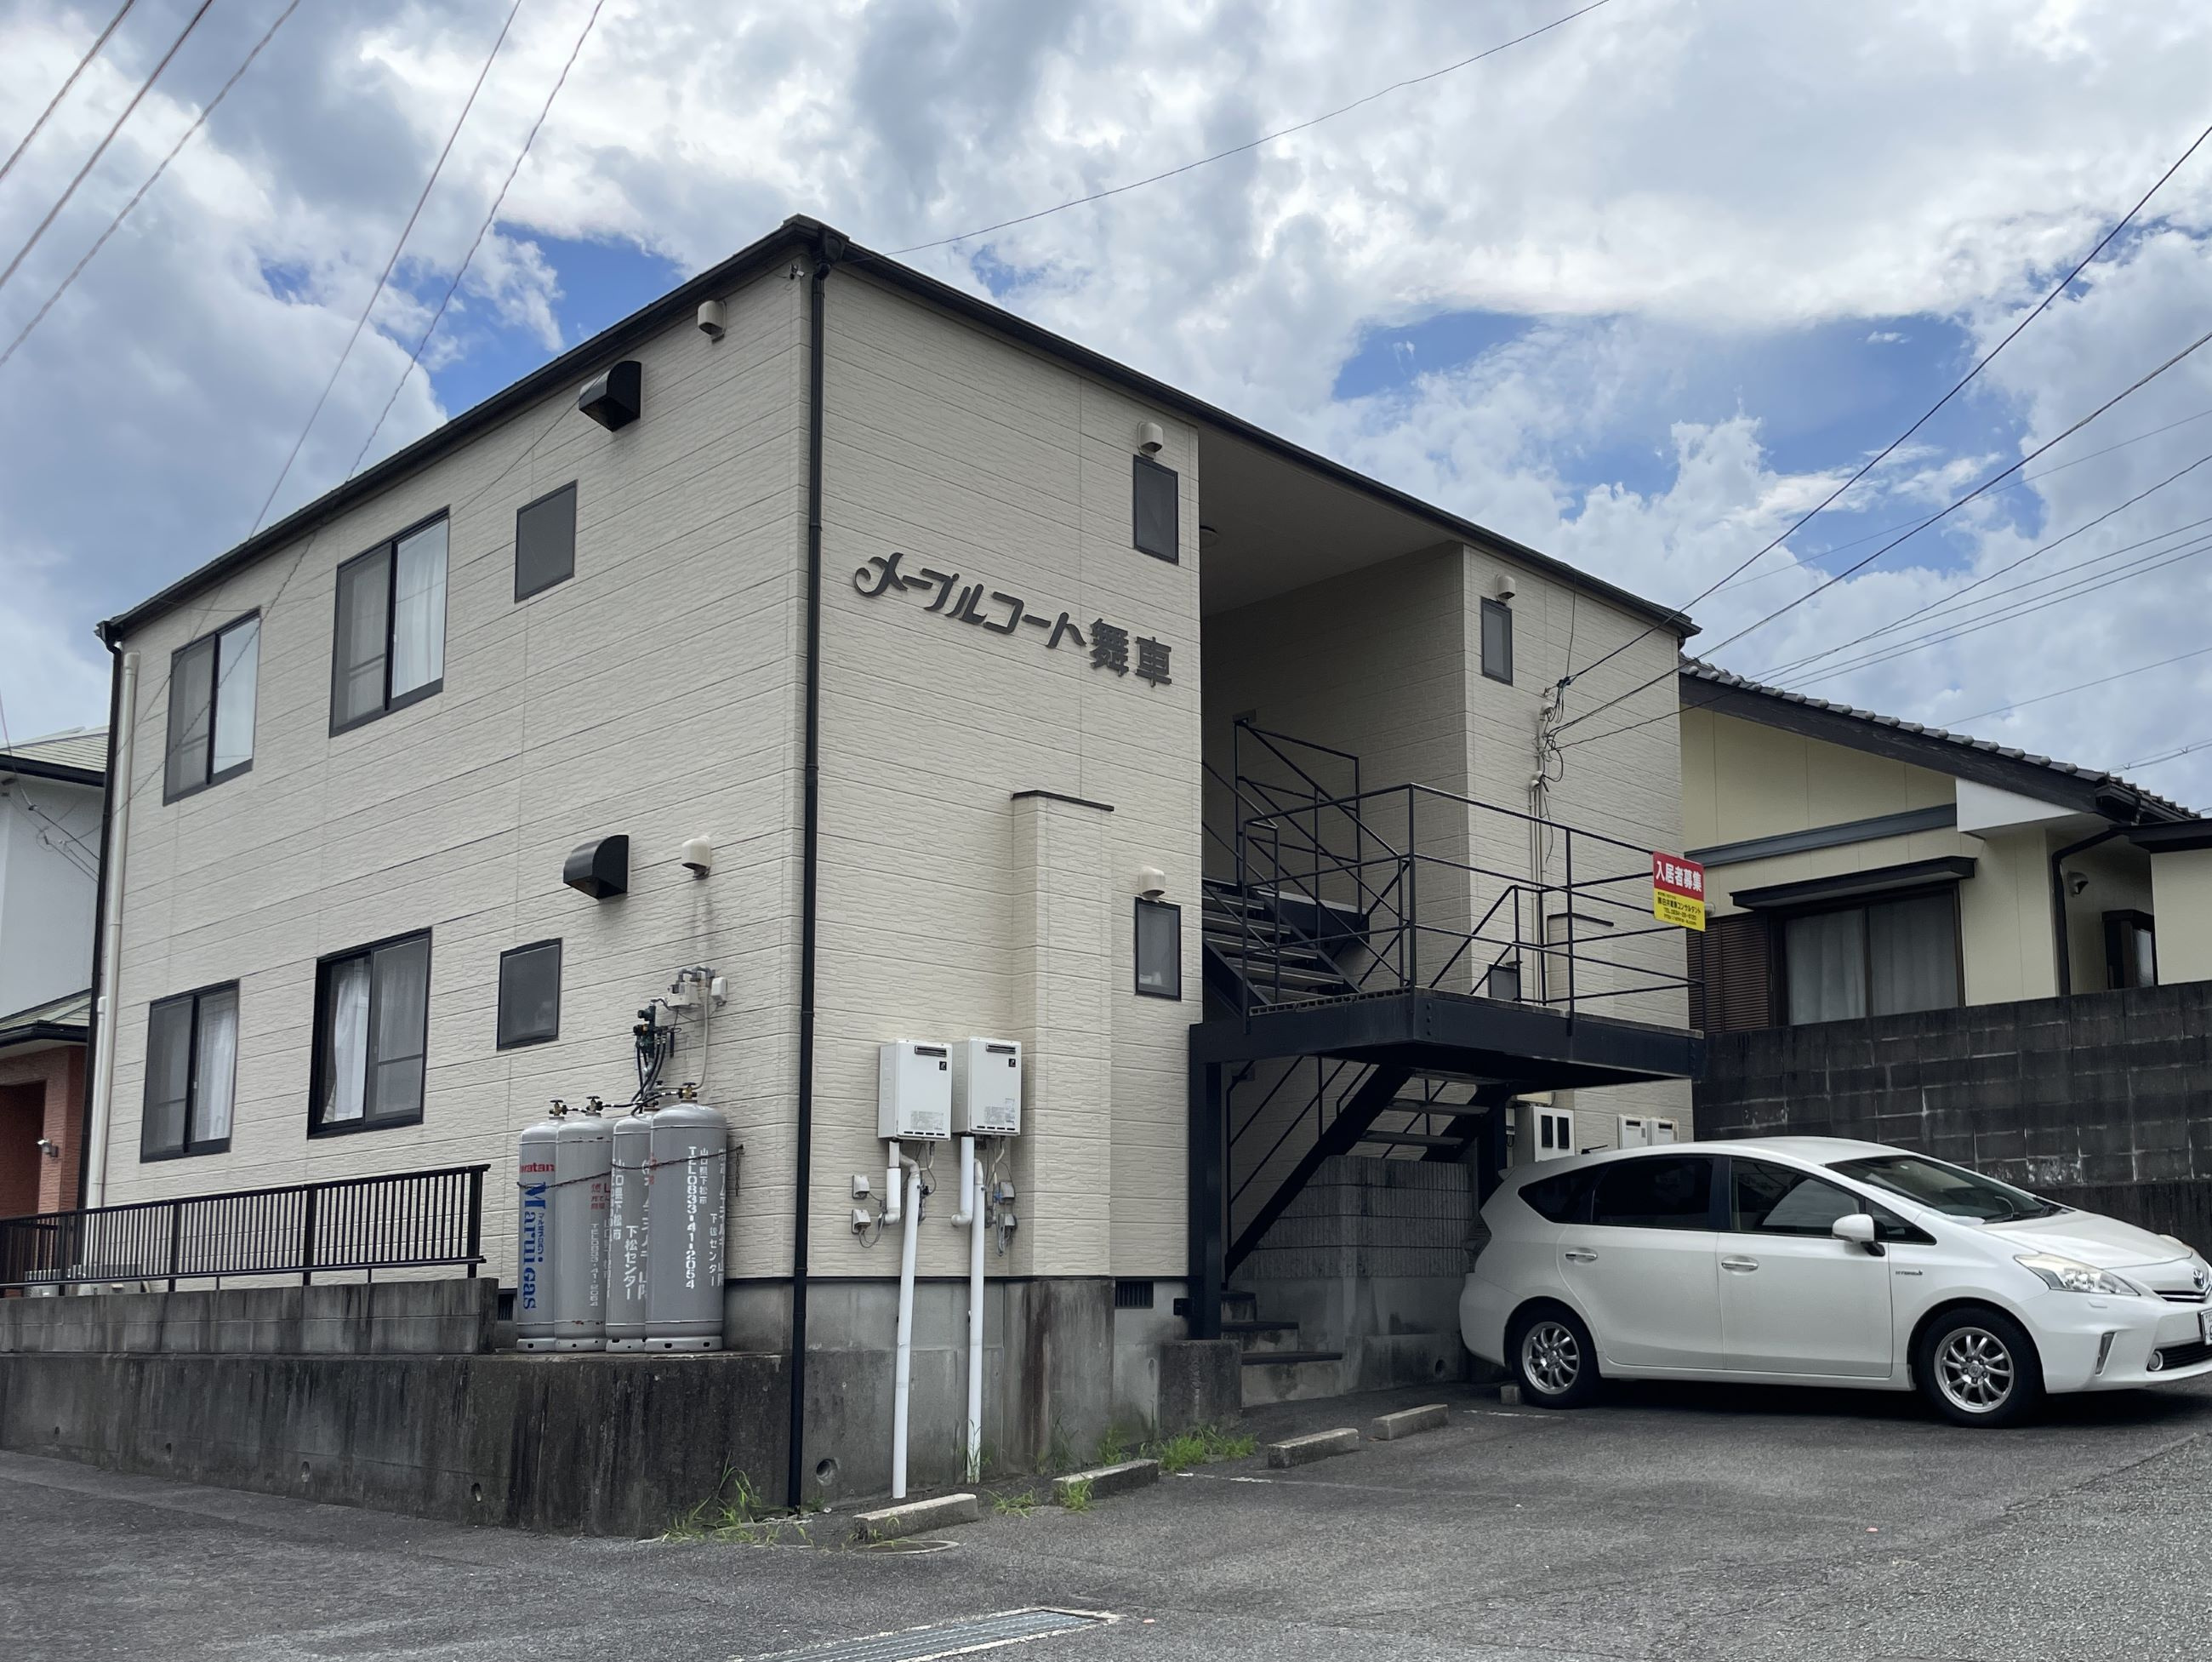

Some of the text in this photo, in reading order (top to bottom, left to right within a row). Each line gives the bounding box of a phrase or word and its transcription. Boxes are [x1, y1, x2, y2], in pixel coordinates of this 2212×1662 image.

[1656, 860, 1702, 893] 入居者募集
[523, 1181, 546, 1265] Marui
[623, 1225, 639, 1300] 下松センター
